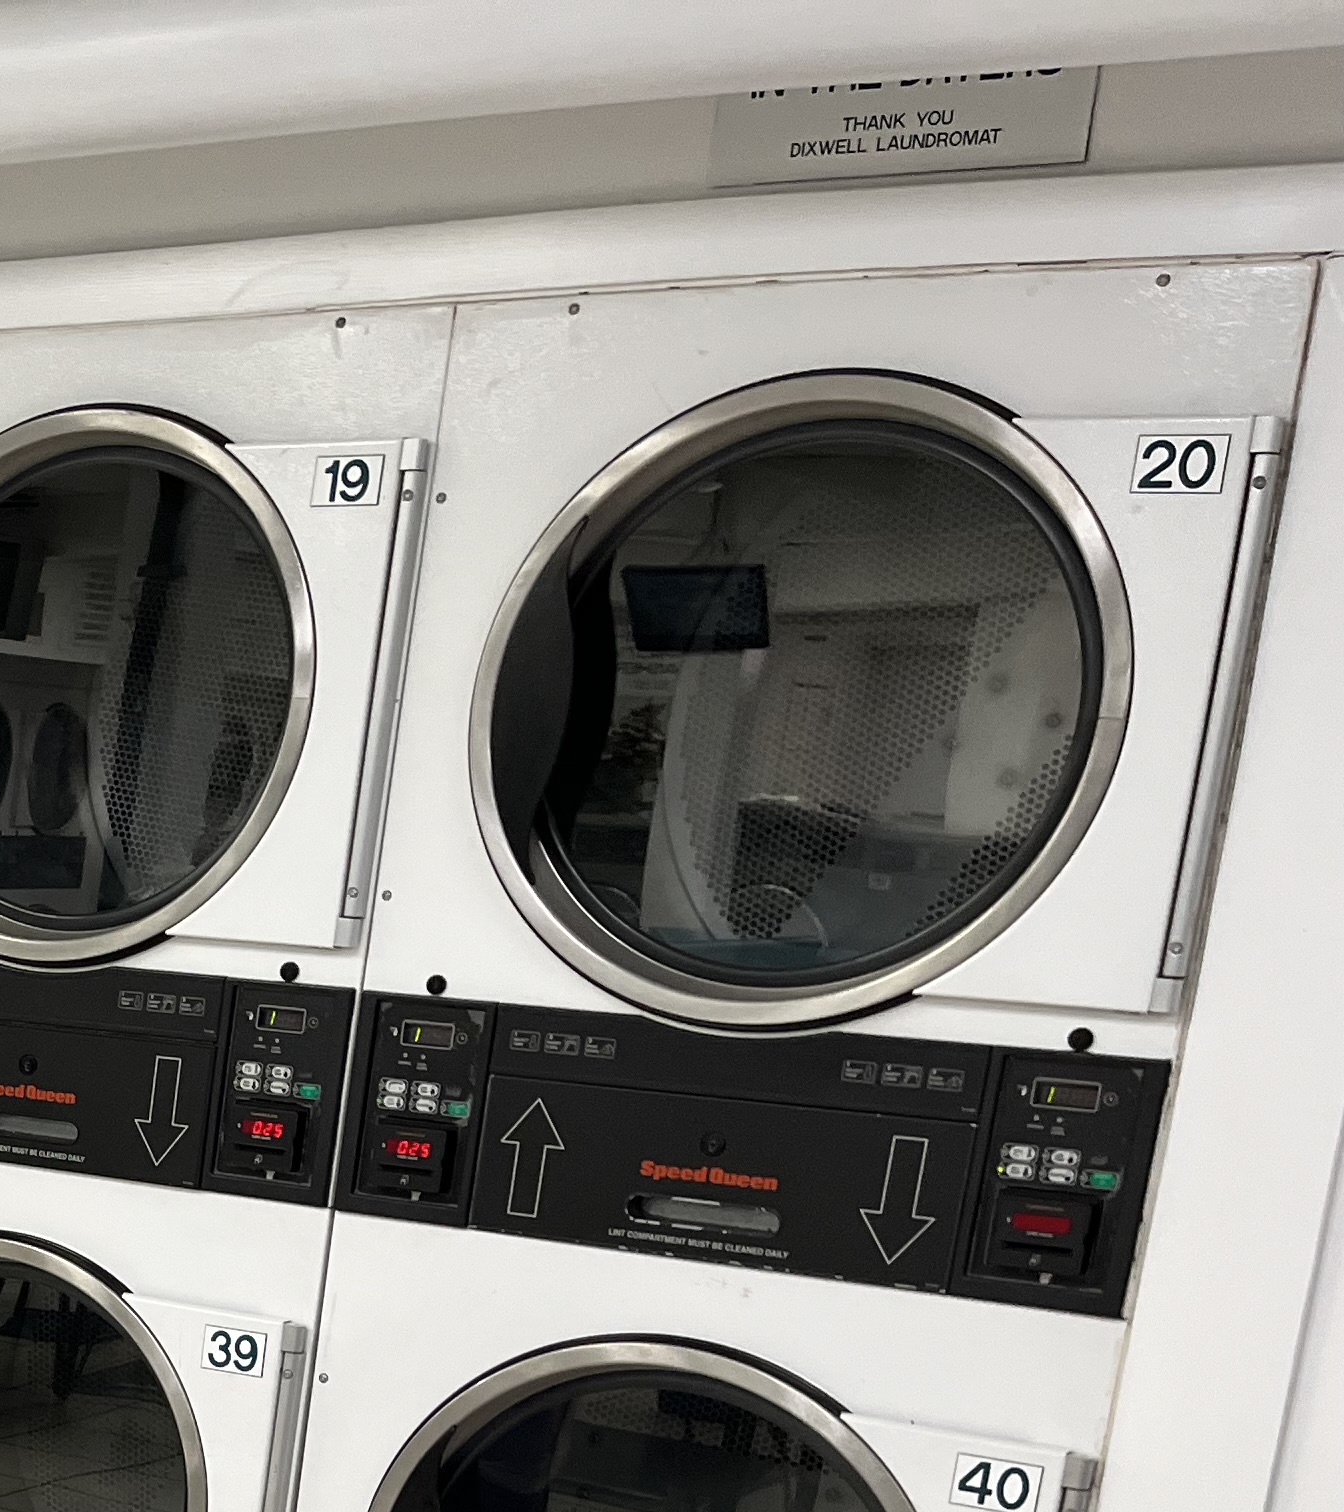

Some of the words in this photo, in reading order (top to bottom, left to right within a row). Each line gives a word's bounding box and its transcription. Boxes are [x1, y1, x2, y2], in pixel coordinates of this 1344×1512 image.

[843, 112, 906, 132] THANK
[917, 109, 955, 127] YOU
[790, 137, 868, 158] DIXWELL
[876, 128, 1003, 153] LAUNDROMAT
[325, 459, 369, 502] 19
[1137, 439, 1216, 489] 20
[26, 1085, 77, 1104] Queen
[639, 1159, 709, 1182] Speed
[709, 1166, 779, 1191] Queen
[608, 1227, 626, 1237] LINT
[627, 1229, 687, 1246] COMPARTMENT
[688, 1238, 711, 1249] MUST
[712, 1240, 723, 1251] BE
[724, 1242, 763, 1256] CLEANED
[764, 1248, 791, 1260] DAILY
[208, 1330, 258, 1372] 39
[958, 1461, 1030, 1510] 40
